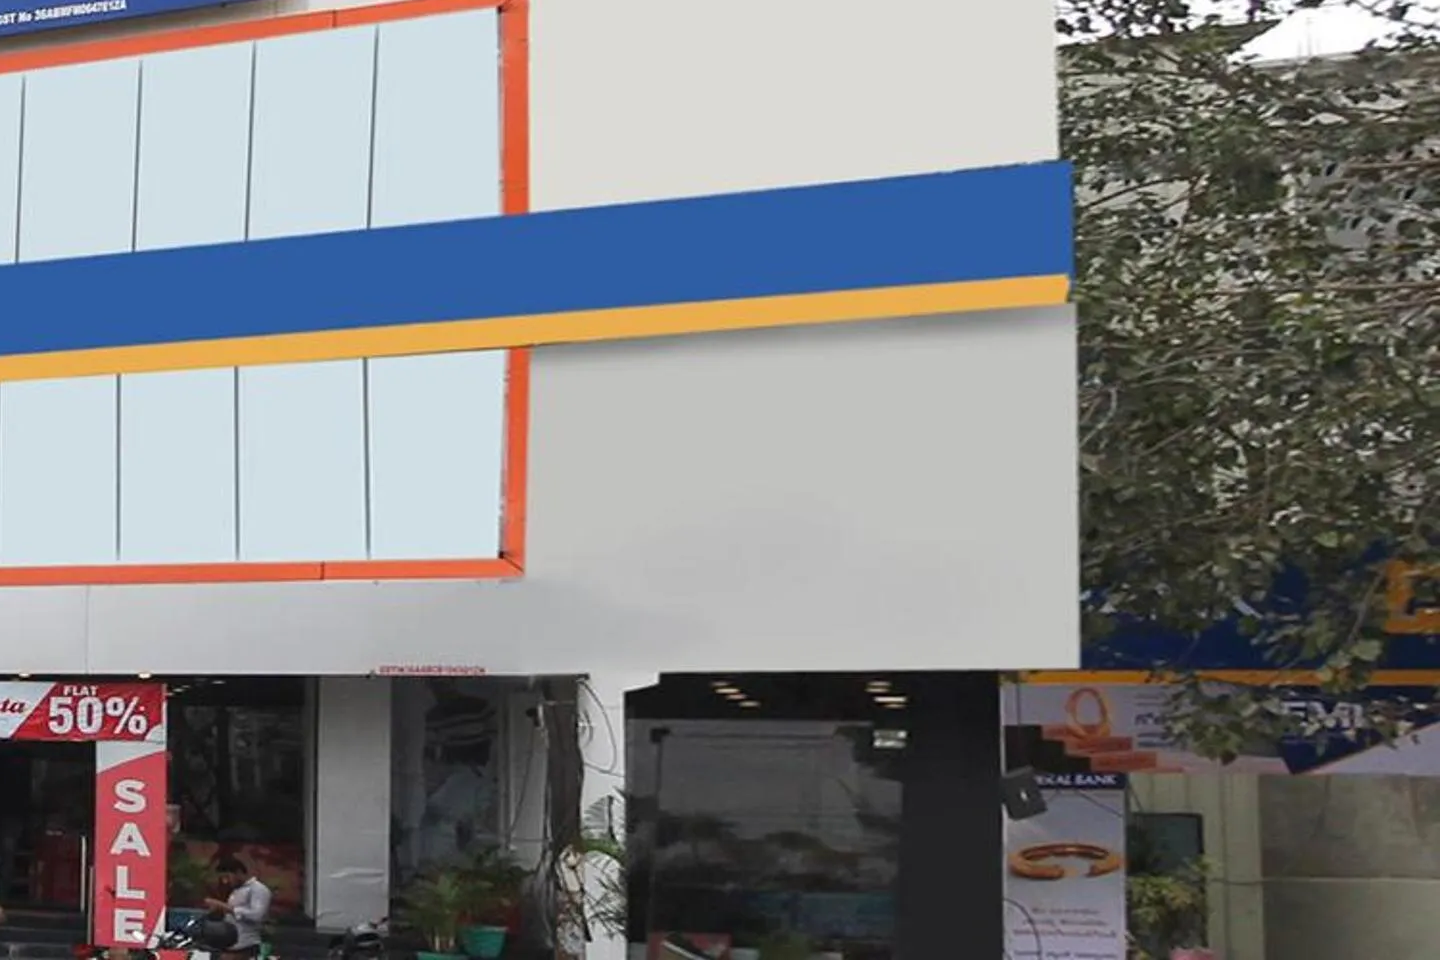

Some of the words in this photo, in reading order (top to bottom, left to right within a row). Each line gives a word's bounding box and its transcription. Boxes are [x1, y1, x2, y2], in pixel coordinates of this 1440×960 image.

[64, 685, 98, 697] FLAT
[48, 696, 148, 735] 50%
[1075, 773, 1117, 785] BANK
[110, 779, 151, 944] SALE
